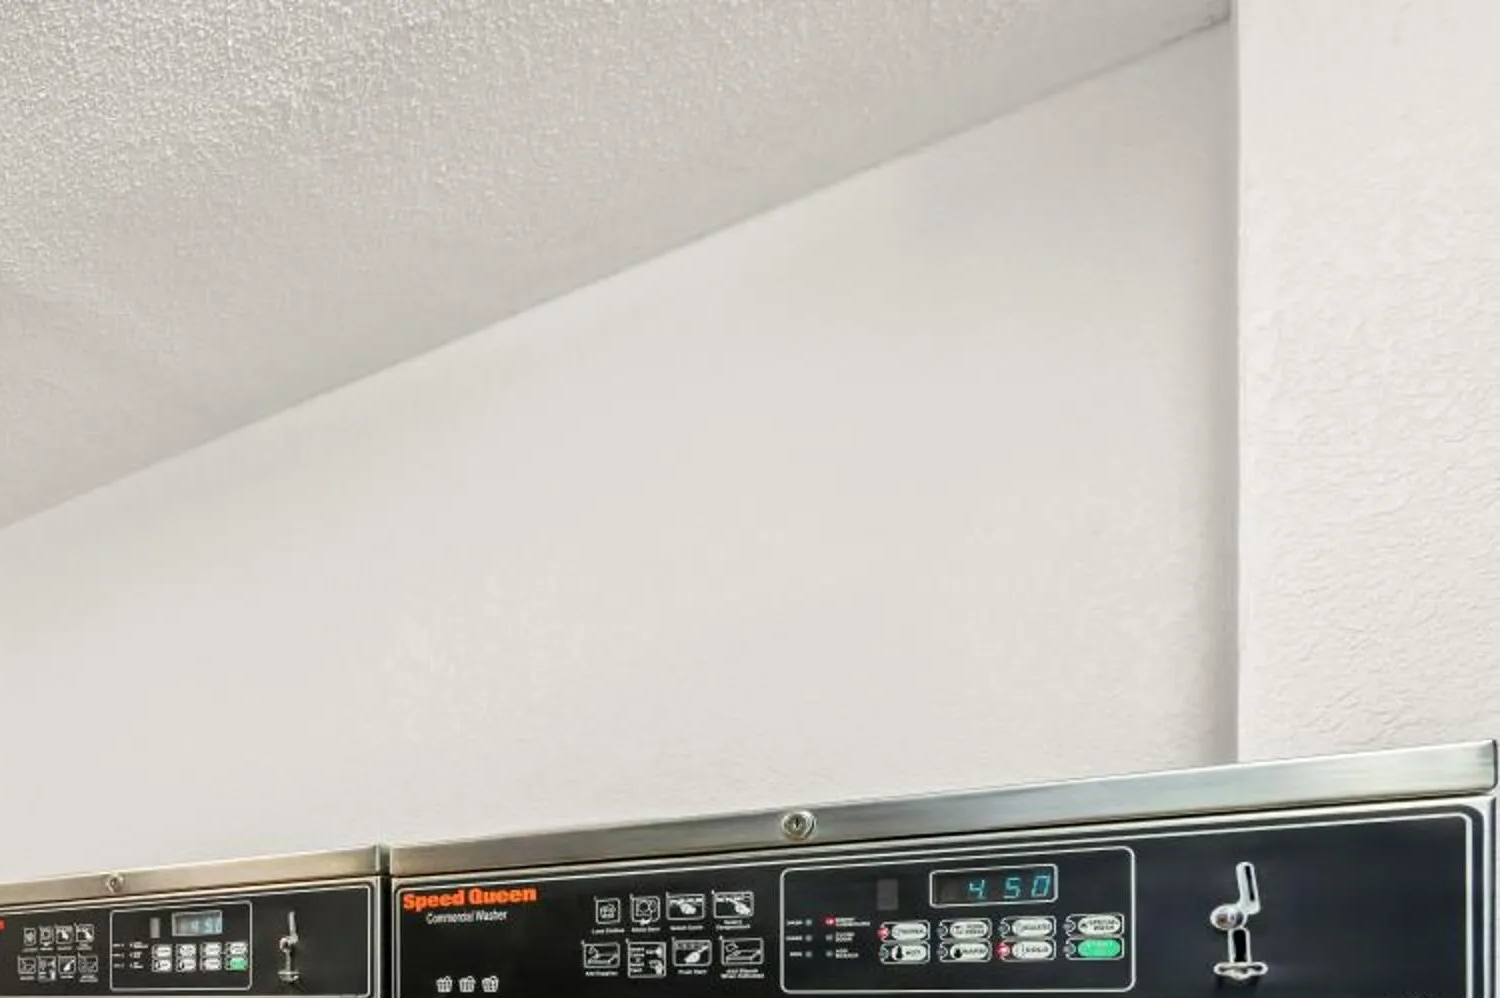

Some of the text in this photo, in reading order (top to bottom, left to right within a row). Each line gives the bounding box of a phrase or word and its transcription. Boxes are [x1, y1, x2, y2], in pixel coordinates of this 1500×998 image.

[403, 887, 537, 912] Speed Queen
[425, 910, 508, 925] Commercial Washer
